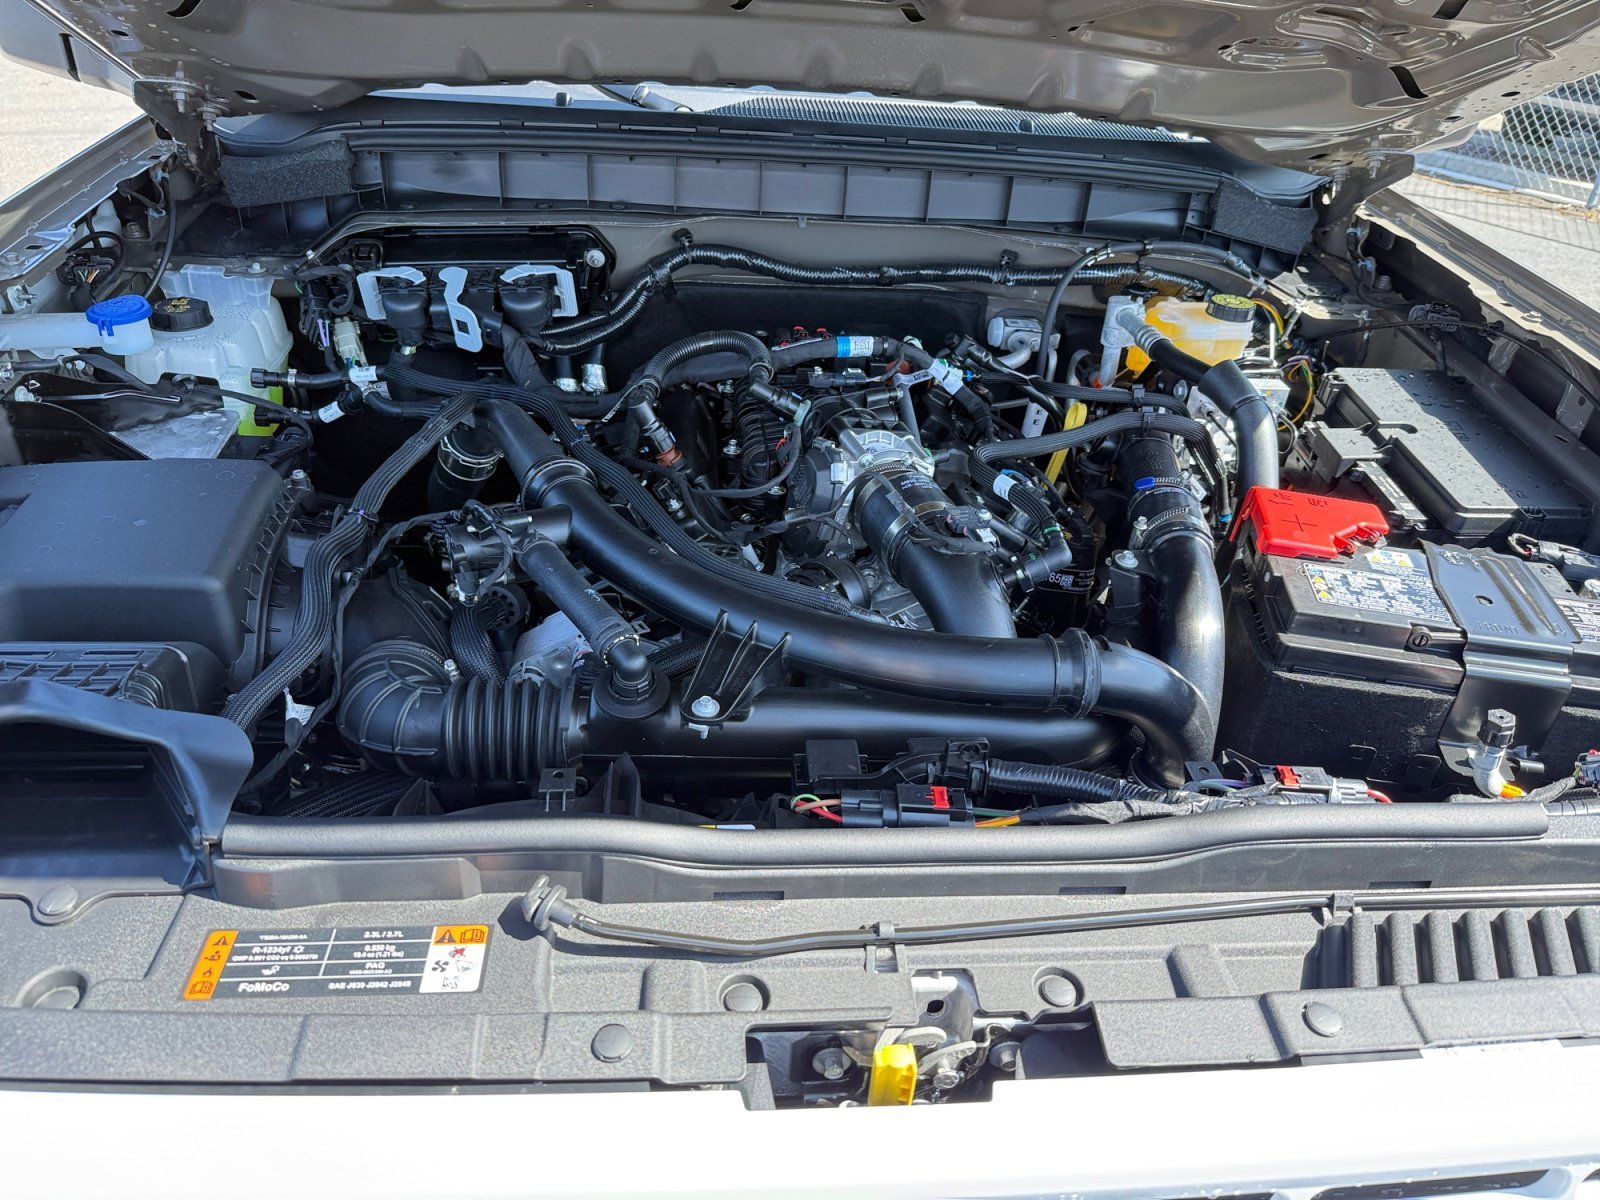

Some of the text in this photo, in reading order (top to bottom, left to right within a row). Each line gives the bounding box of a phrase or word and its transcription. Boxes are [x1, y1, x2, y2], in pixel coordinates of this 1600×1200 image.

[386, 930, 404, 938] 2.7L
[251, 945, 292, 954] R-1234yf
[237, 981, 290, 993] FoMoCo
[328, 981, 346, 989] SAE
[346, 981, 365, 989] J639
